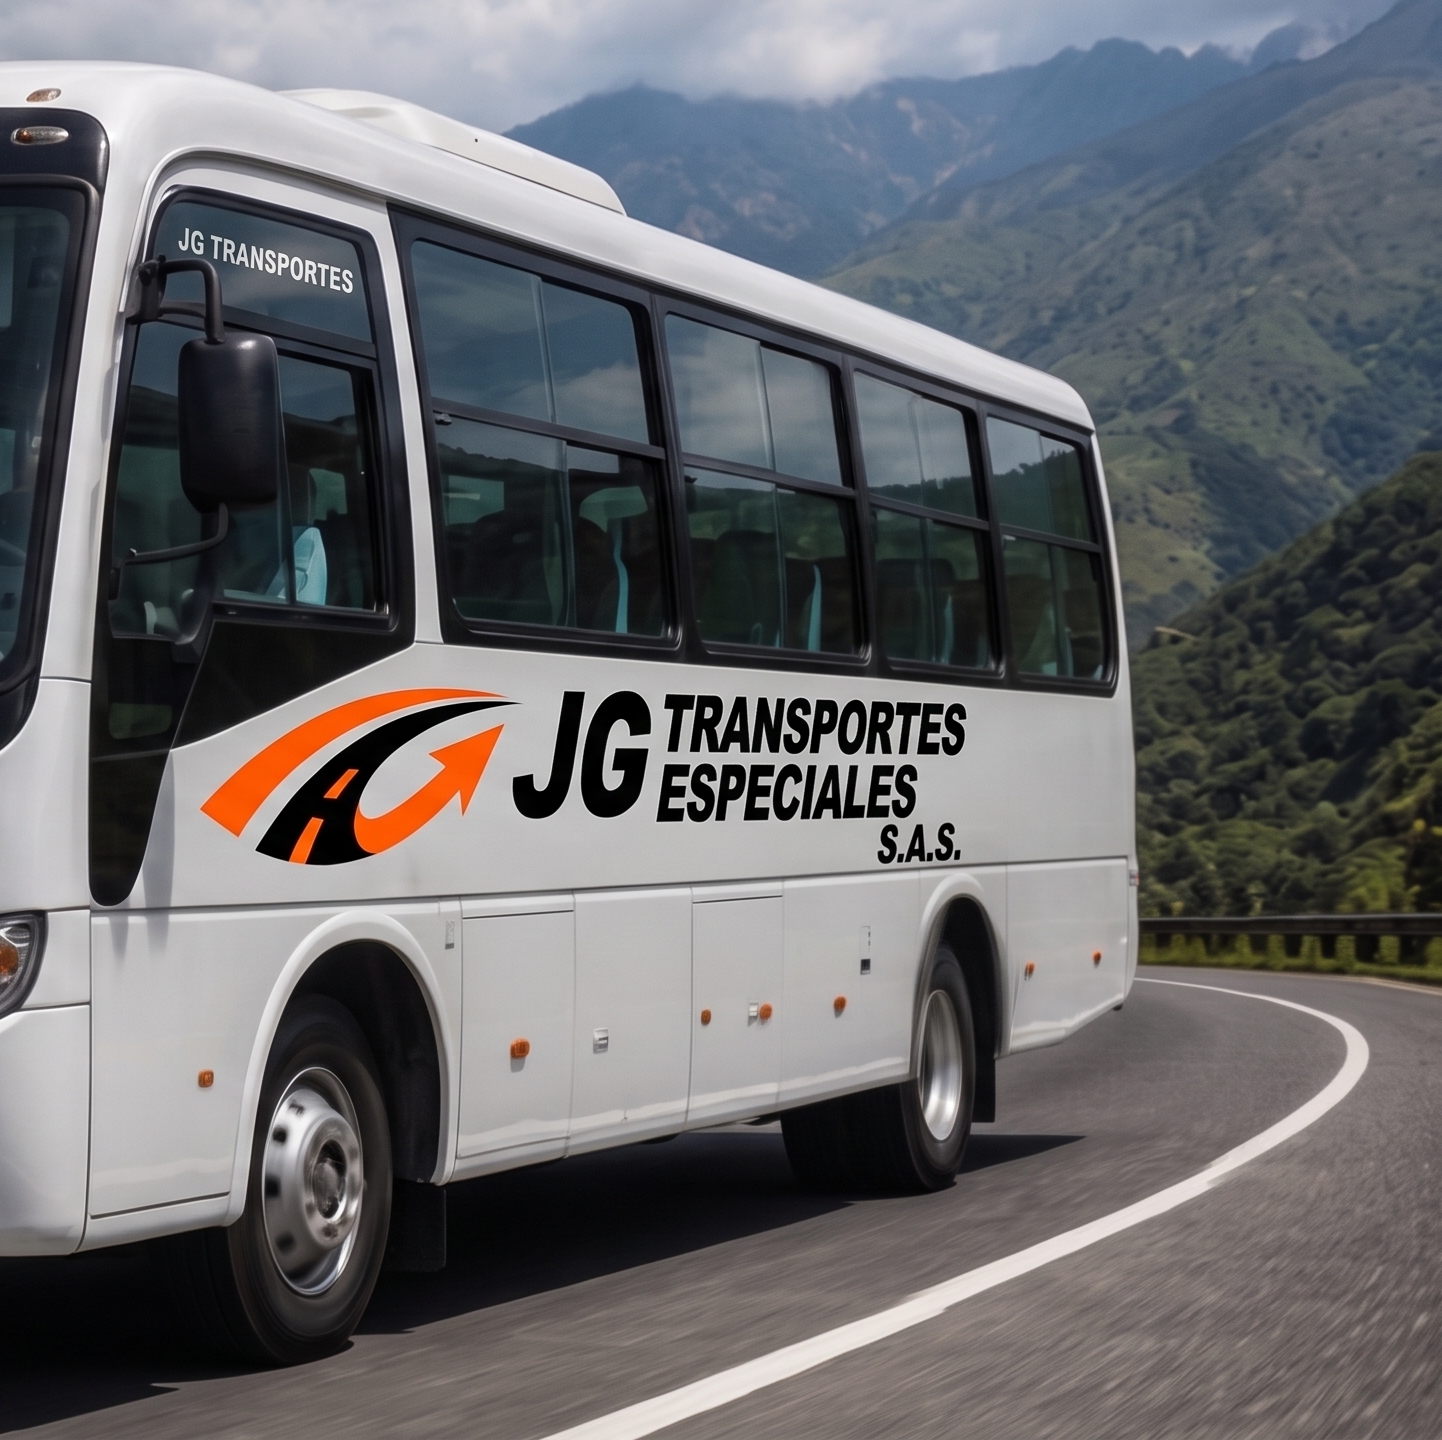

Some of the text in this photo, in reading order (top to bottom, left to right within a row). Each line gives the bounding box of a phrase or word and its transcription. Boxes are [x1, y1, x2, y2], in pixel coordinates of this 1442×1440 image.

[178, 227, 354, 294] JG TRANSPORTES
[512, 690, 652, 820] JG
[663, 693, 967, 756] TRANSPORTES
[656, 763, 918, 823] ESPECIALES
[877, 822, 961, 865] S.A.S.
